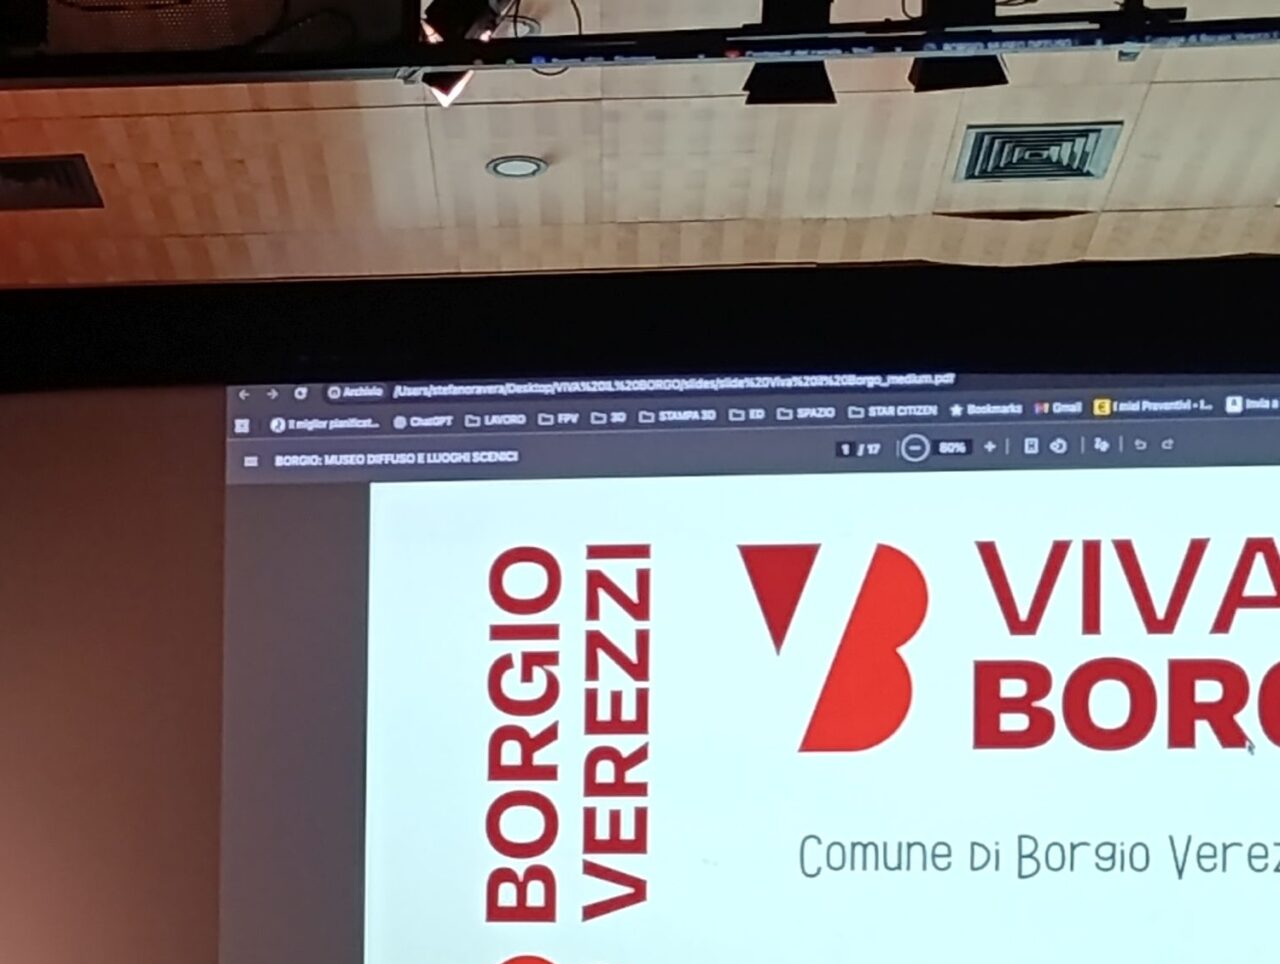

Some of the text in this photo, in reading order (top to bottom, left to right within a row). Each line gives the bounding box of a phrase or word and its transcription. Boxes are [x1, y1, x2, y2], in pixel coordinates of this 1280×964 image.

[796, 407, 836, 419] SPAZIO
[868, 404, 938, 417] STAR CITIZEN
[966, 403, 1023, 415] Bookmarks
[1052, 401, 1083, 413] Gmail
[410, 415, 454, 427] ChatGPT
[484, 414, 527, 425] LAVORO
[658, 410, 699, 422] STAMPA
[274, 450, 519, 467] BORGIO: MUSEO DIFFUSO E LUOGHI SCENICI
[974, 537, 1280, 636] VIVA
[973, 656, 1280, 751] BOR
[485, 545, 562, 922] BORGIO
[581, 543, 651, 922] VEREZZI
[800, 834, 952, 878] Comune
[1017, 835, 1150, 879] Borgio
